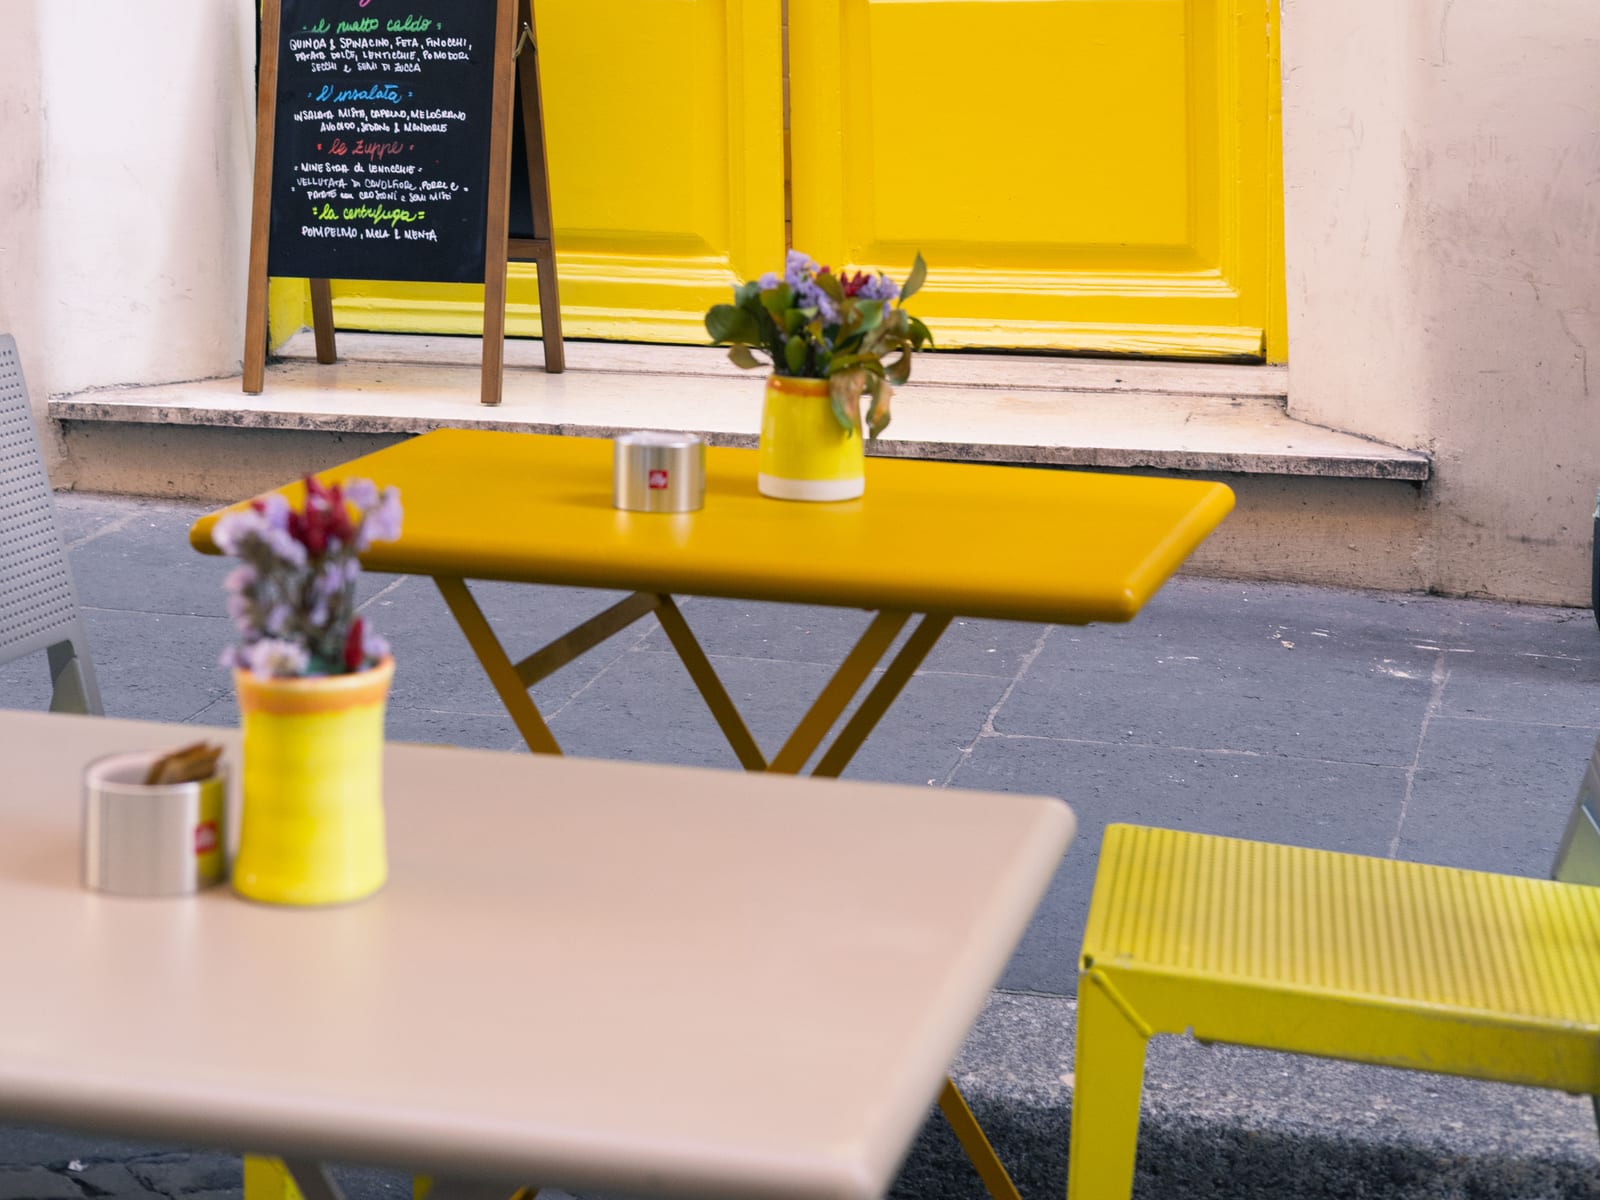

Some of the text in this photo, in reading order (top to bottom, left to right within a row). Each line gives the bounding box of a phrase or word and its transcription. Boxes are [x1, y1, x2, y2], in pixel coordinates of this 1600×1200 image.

[290, 38, 327, 50] QUINOA
[394, 63, 421, 73] ZUCCA
[297, 178, 348, 189] VELLUTATA
[404, 229, 438, 242] MENTA
